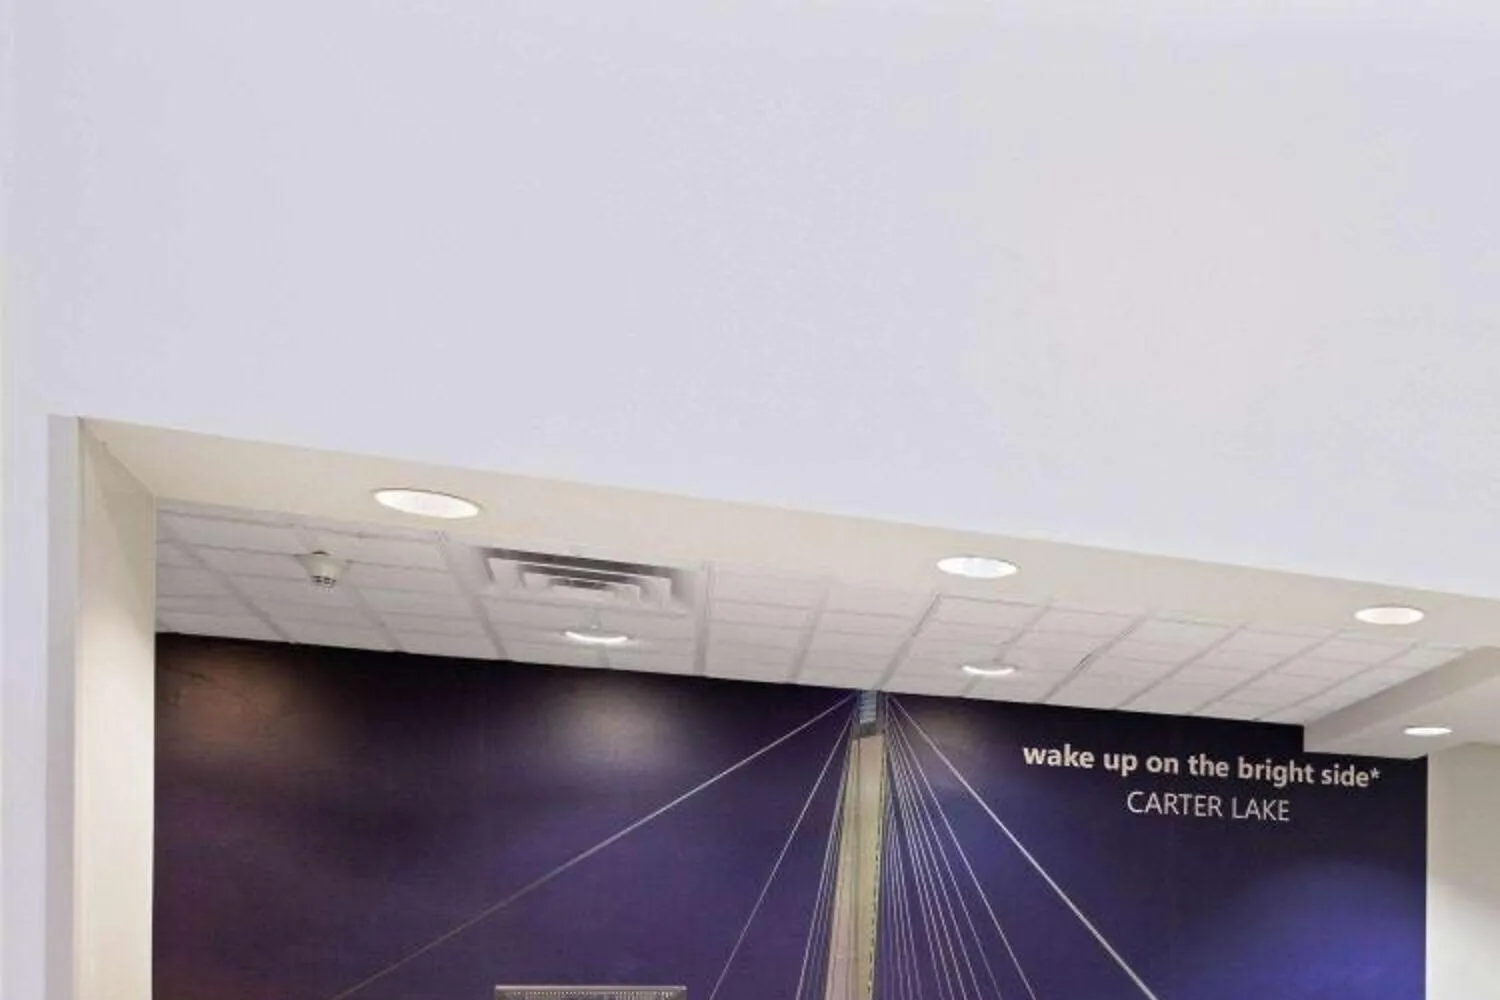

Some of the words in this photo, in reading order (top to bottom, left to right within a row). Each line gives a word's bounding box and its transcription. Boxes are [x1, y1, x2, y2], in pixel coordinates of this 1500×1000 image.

[1023, 743, 1095, 769] wake
[1103, 753, 1138, 777] up
[1146, 755, 1179, 774] on
[1188, 754, 1230, 778] the
[1238, 757, 1315, 788] bright
[1126, 790, 1223, 818] CARTER
[1231, 797, 1290, 822] LAKE
